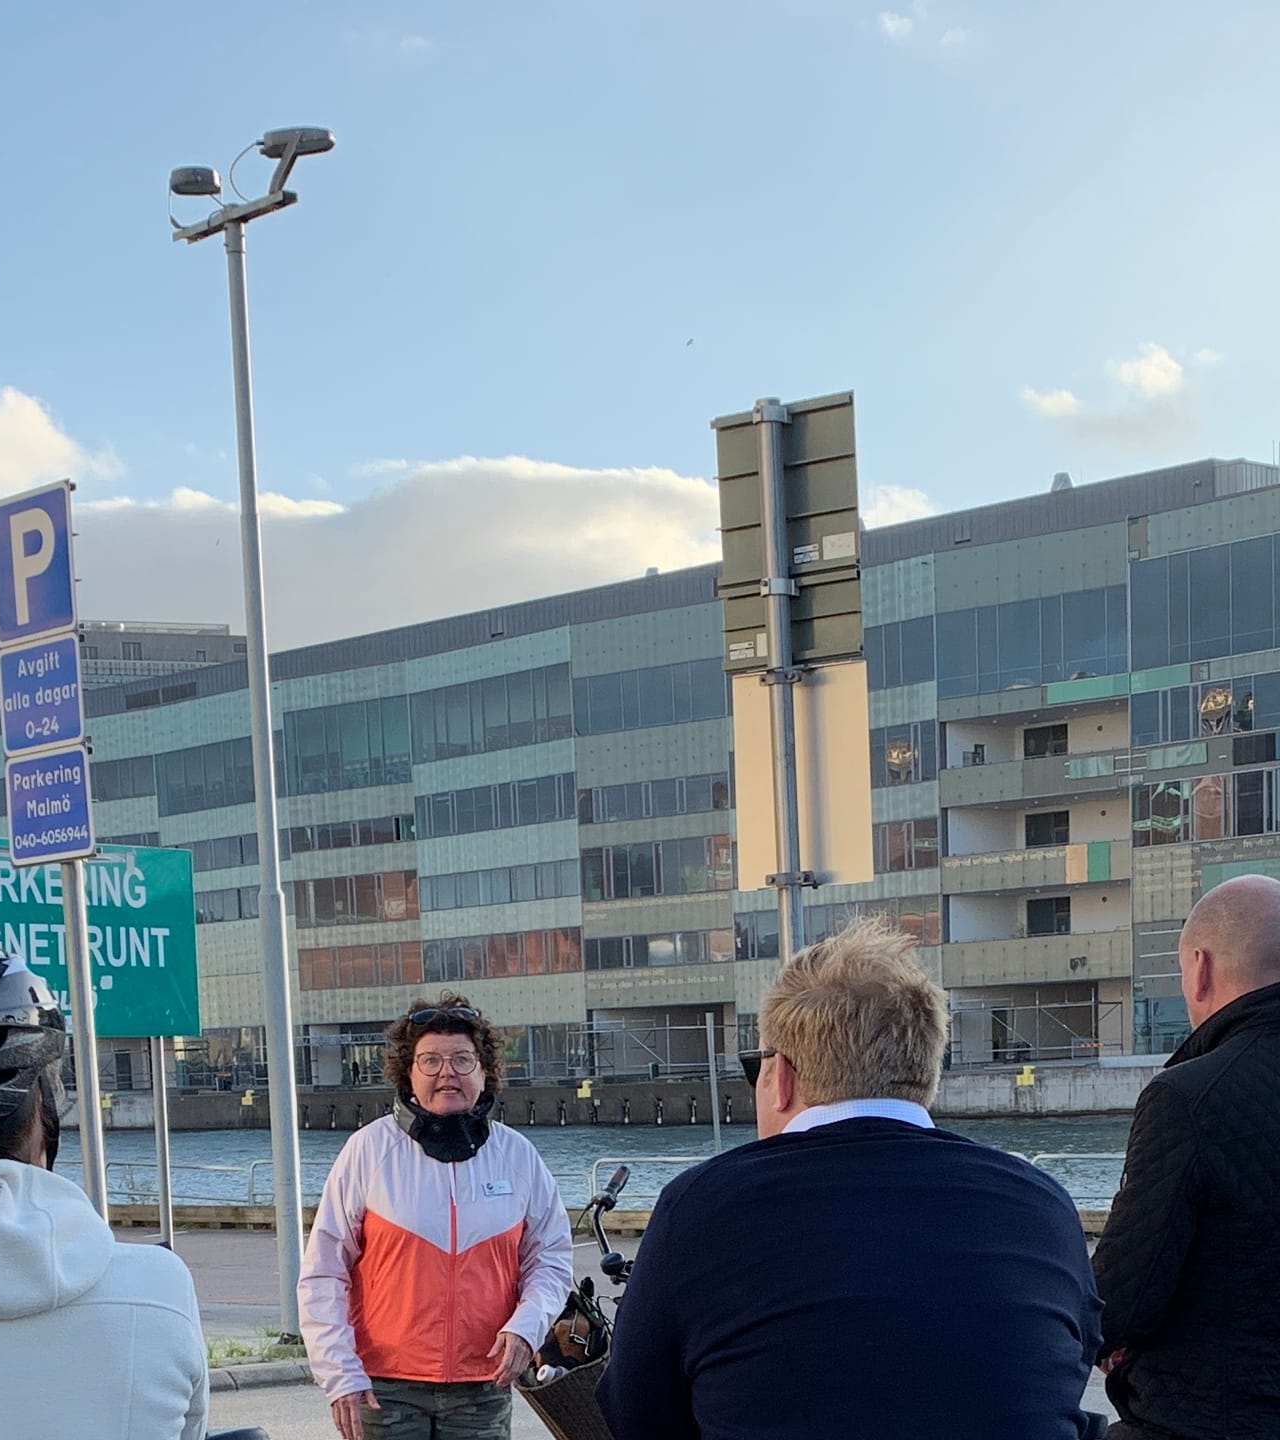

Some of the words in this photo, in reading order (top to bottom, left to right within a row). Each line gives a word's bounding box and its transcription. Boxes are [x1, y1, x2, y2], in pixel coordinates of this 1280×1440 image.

[9, 508, 55, 626] P
[18, 651, 60, 678] Avgift
[4, 692, 30, 712] alla
[35, 683, 77, 706] dagar
[25, 716, 60, 739] 0-24
[13, 764, 81, 791] Parkering
[26, 793, 71, 819] Malmö
[14, 825, 89, 850] 040-6056944
